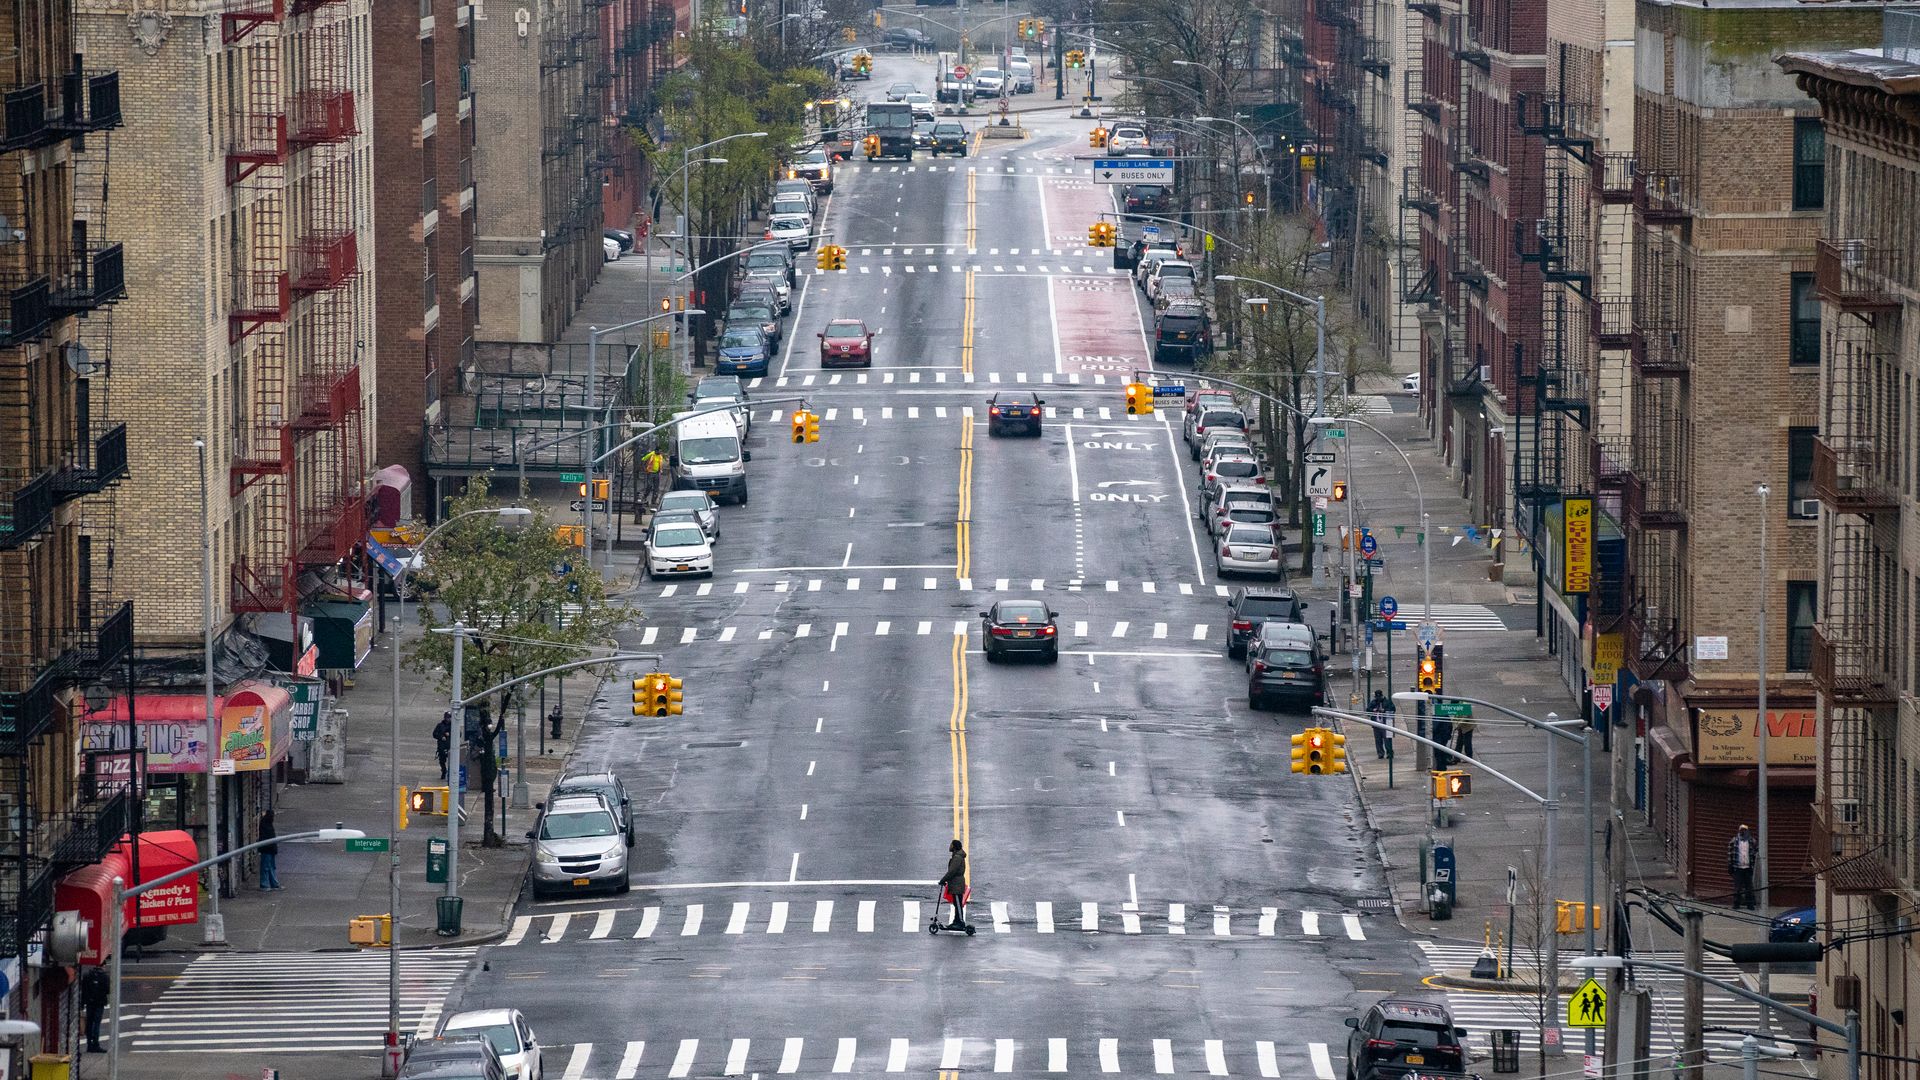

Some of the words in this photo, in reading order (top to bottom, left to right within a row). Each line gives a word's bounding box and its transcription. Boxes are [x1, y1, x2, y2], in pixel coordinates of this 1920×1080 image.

[1068, 355, 1137, 363] ONLY
[1080, 364, 1132, 372] BUS
[1083, 441, 1159, 450] ONLY
[1089, 492, 1170, 503] ONLY
[1595, 687, 1611, 697] ATM
[1753, 711, 1817, 737] Mi
[149, 723, 182, 754] INC
[354, 839, 381, 847] Intervale
[167, 898, 173, 906] &
[175, 897, 192, 906] Pizza
